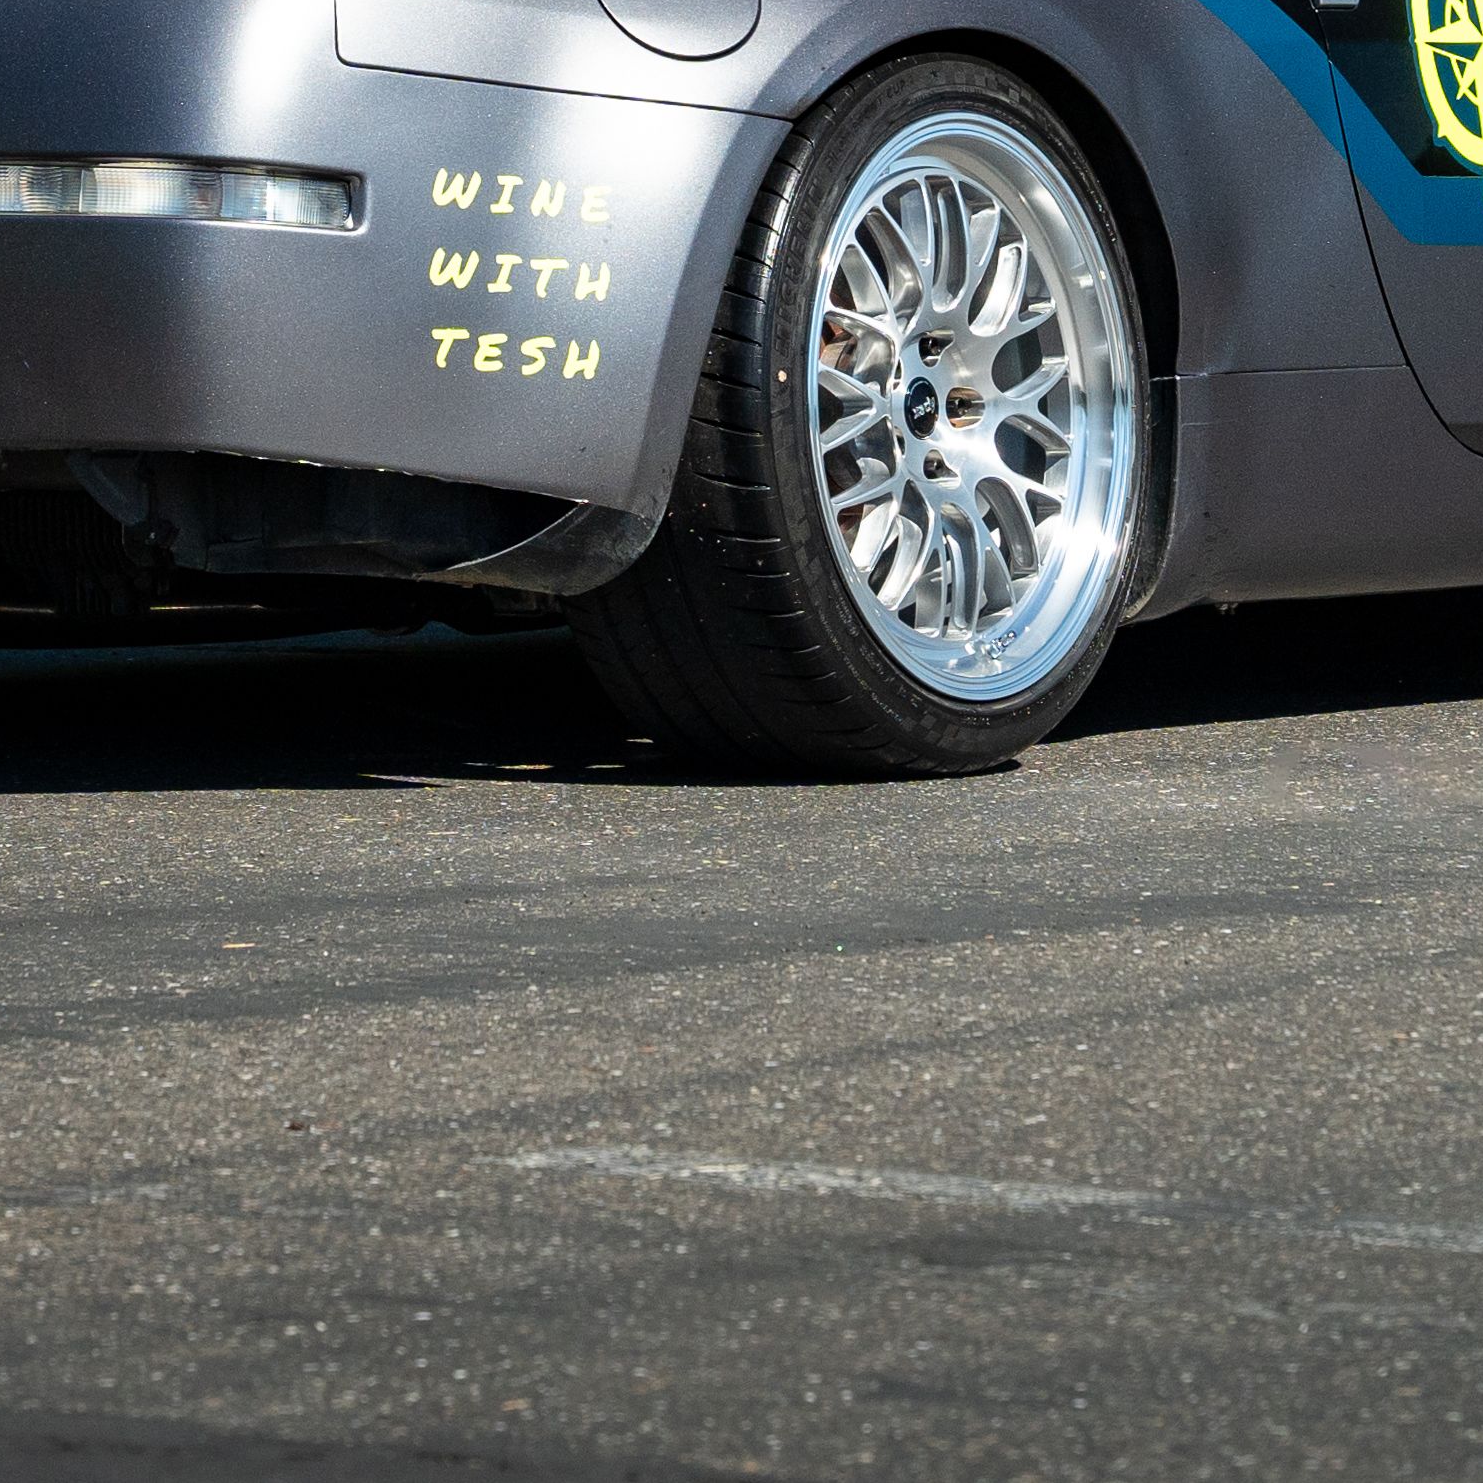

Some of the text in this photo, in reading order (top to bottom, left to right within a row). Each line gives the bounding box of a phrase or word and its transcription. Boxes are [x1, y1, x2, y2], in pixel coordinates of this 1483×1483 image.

[432, 167, 613, 223] WINE
[428, 247, 612, 301] WITH
[431, 327, 601, 380] TESH
